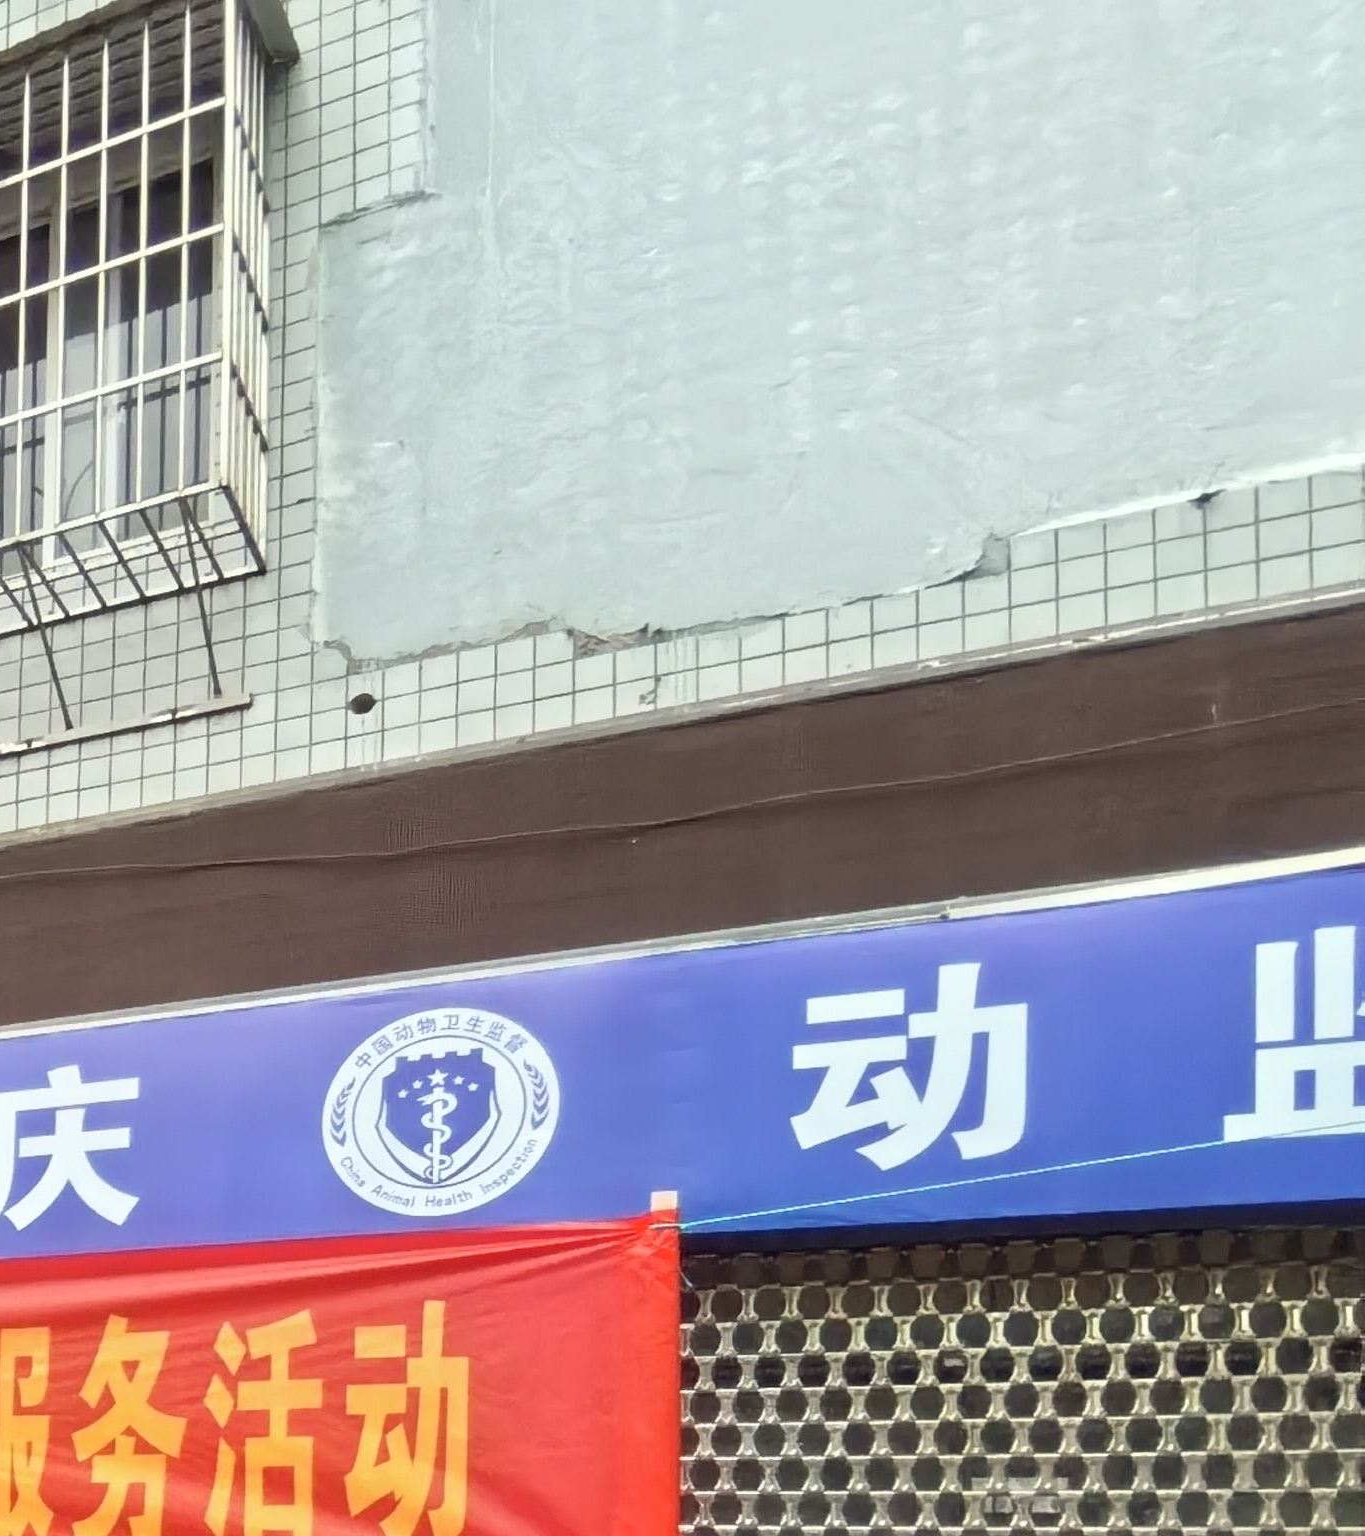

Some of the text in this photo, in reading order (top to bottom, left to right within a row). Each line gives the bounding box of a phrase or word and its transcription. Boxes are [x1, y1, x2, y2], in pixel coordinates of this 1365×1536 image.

[355, 1013, 529, 1070] 中国动物卫生监督
[371, 1184, 416, 1207] Animal
[424, 1189, 473, 1208] Health
[478, 1138, 537, 1196] Inspection
